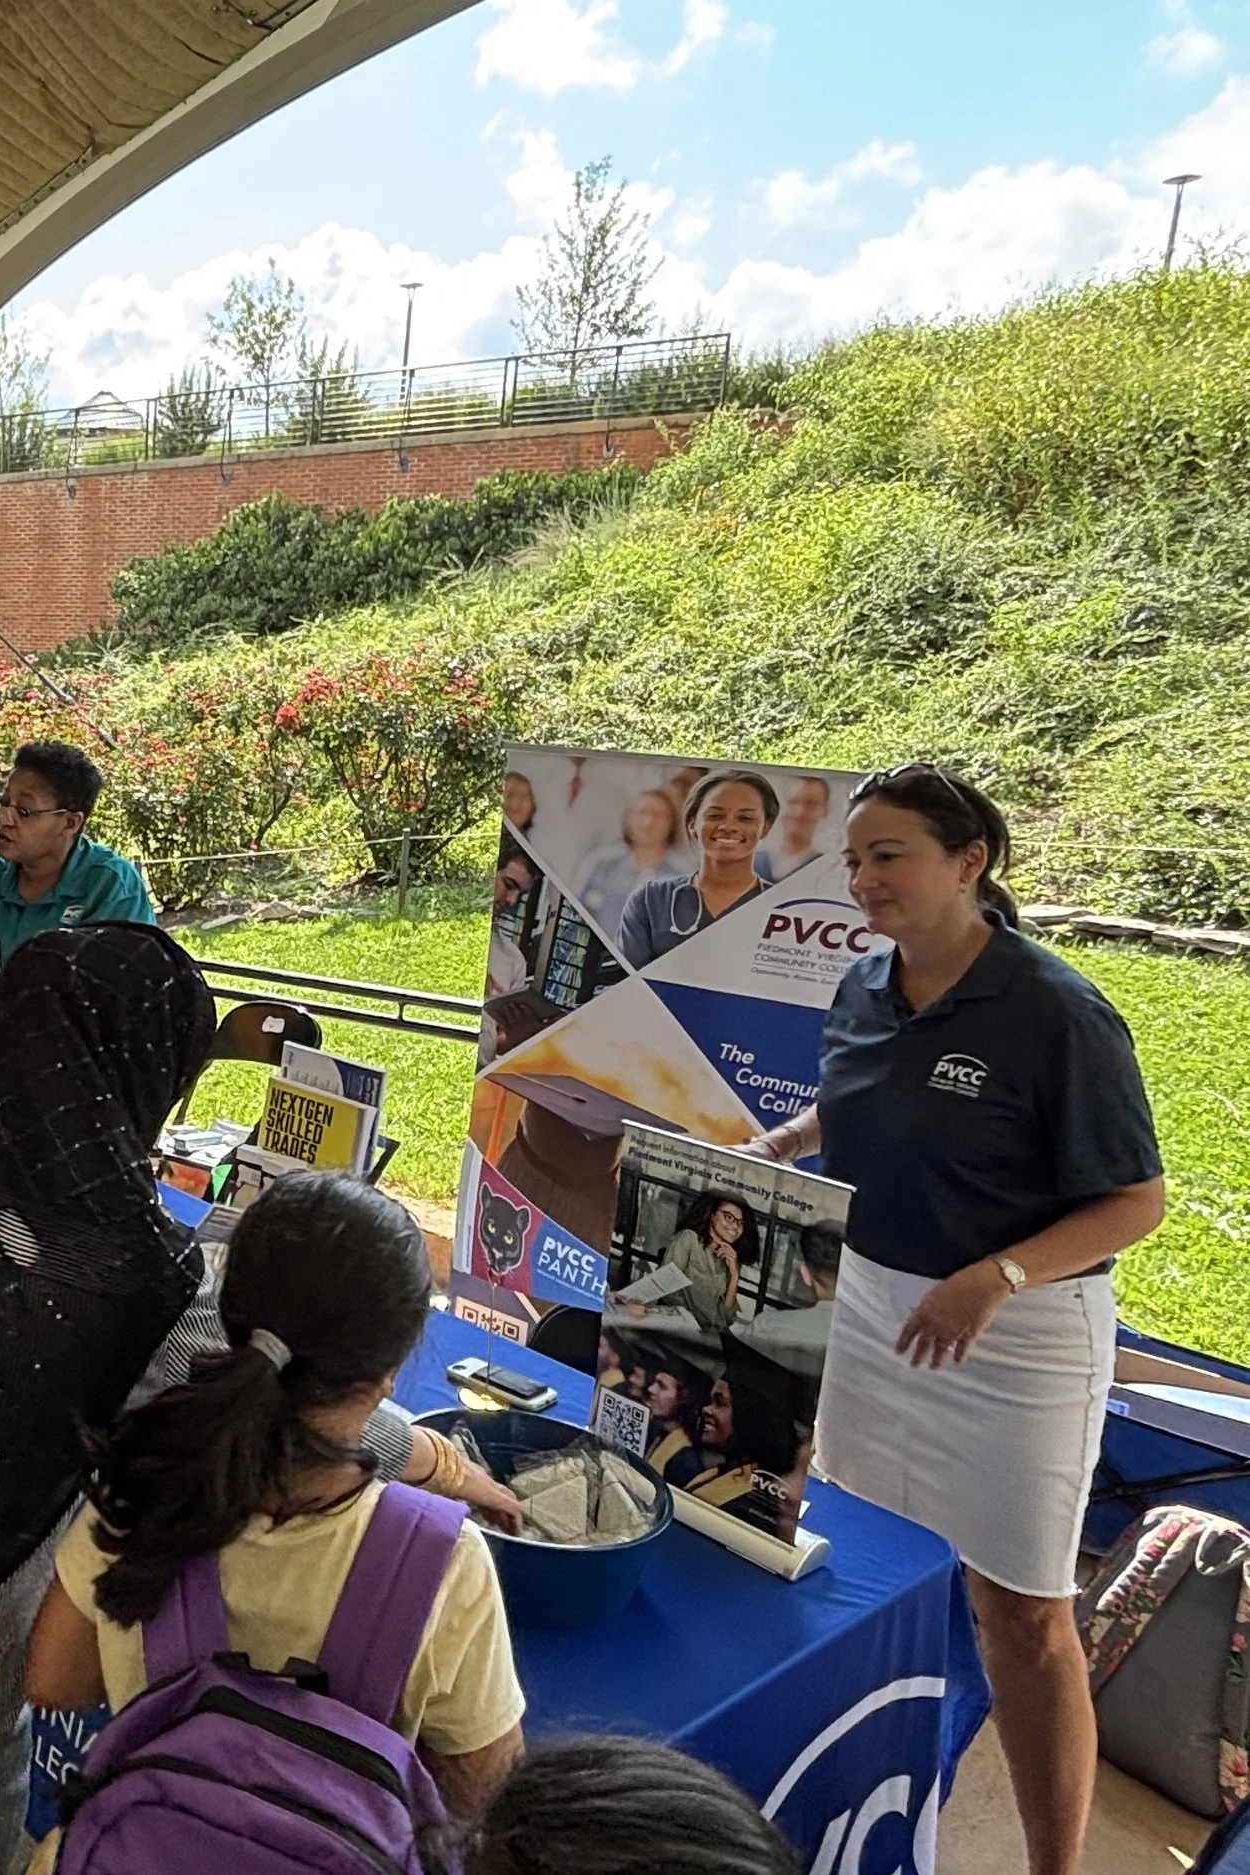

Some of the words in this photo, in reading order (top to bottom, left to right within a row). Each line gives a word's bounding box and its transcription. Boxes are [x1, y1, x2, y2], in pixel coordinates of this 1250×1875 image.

[756, 942, 812, 958] PIEDMONT
[761, 913, 871, 954] PVCC
[753, 952, 818, 970] COMMUNITY
[719, 1042, 755, 1065] The
[933, 1060, 987, 1086] PVCC
[269, 1086, 335, 1128] NEXTGEN
[266, 1107, 324, 1145] SKILLED
[262, 1127, 318, 1165] TRADES
[627, 1146, 673, 1168] Piedmont
[674, 1160, 713, 1179] Virginia
[714, 1172, 771, 1200] Community
[772, 1190, 814, 1212] College
[542, 1236, 597, 1272] PVCC
[537, 1251, 608, 1296] PANTH
[750, 1473, 789, 1500] PVCC
